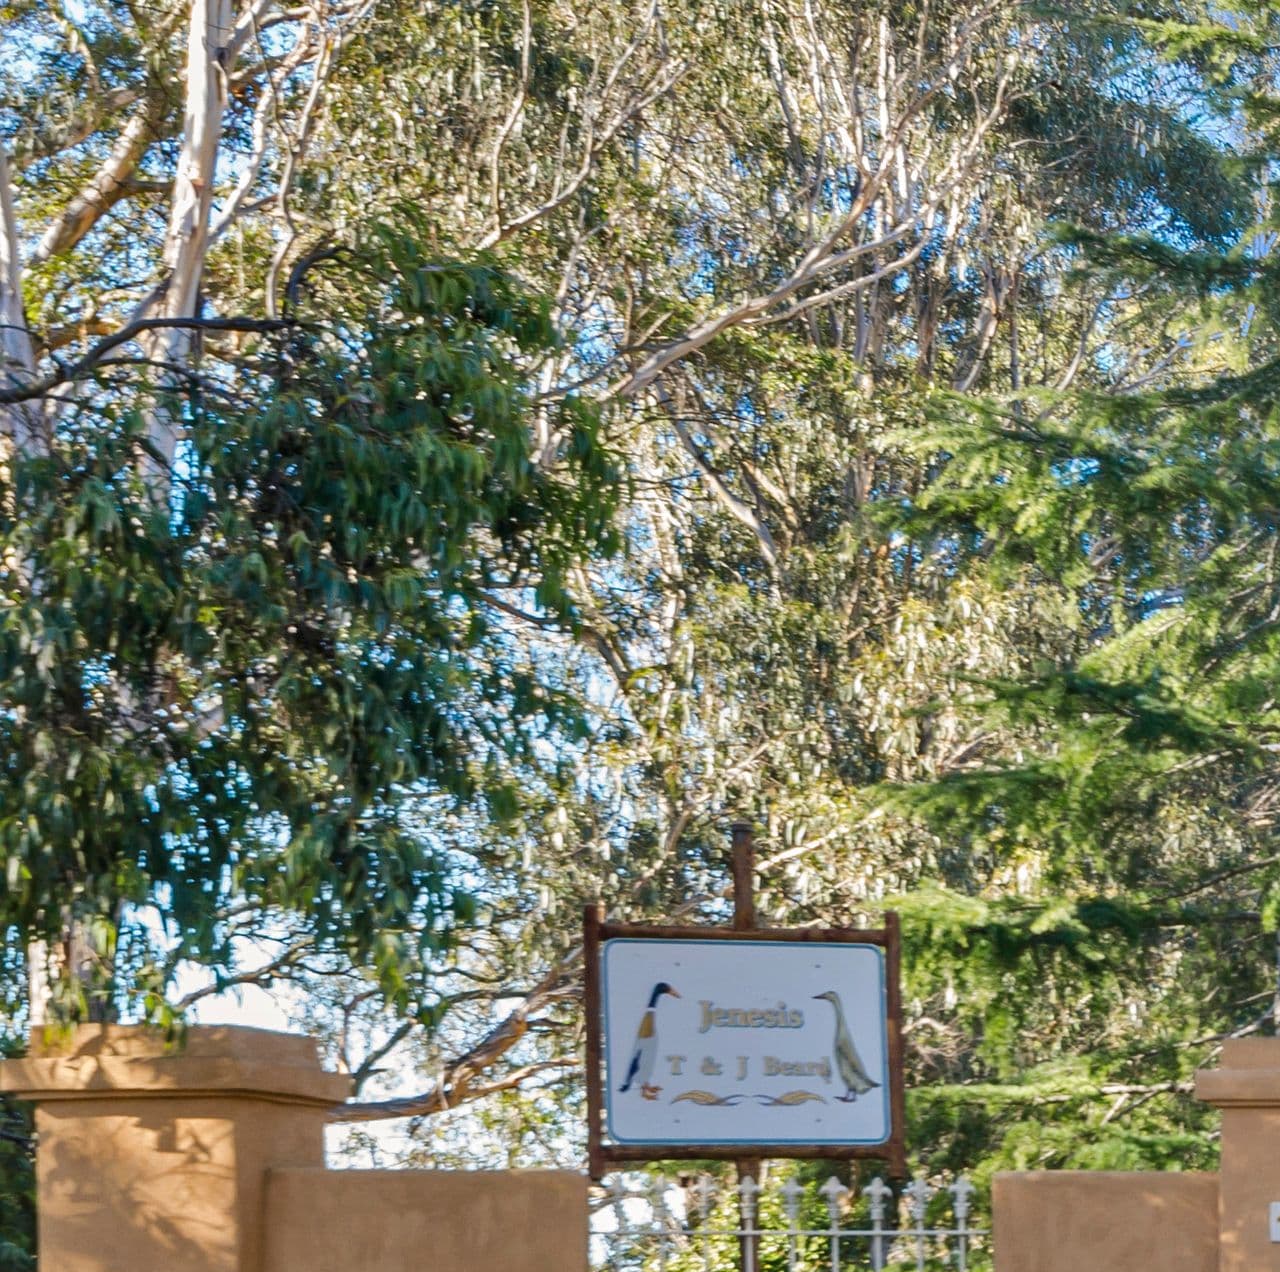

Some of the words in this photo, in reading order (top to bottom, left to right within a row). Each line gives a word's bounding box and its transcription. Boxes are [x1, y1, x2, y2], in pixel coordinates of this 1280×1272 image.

[697, 999, 805, 1034] Jenesis
[666, 1055, 688, 1076] T
[701, 1055, 724, 1076] &
[735, 1055, 750, 1082] J
